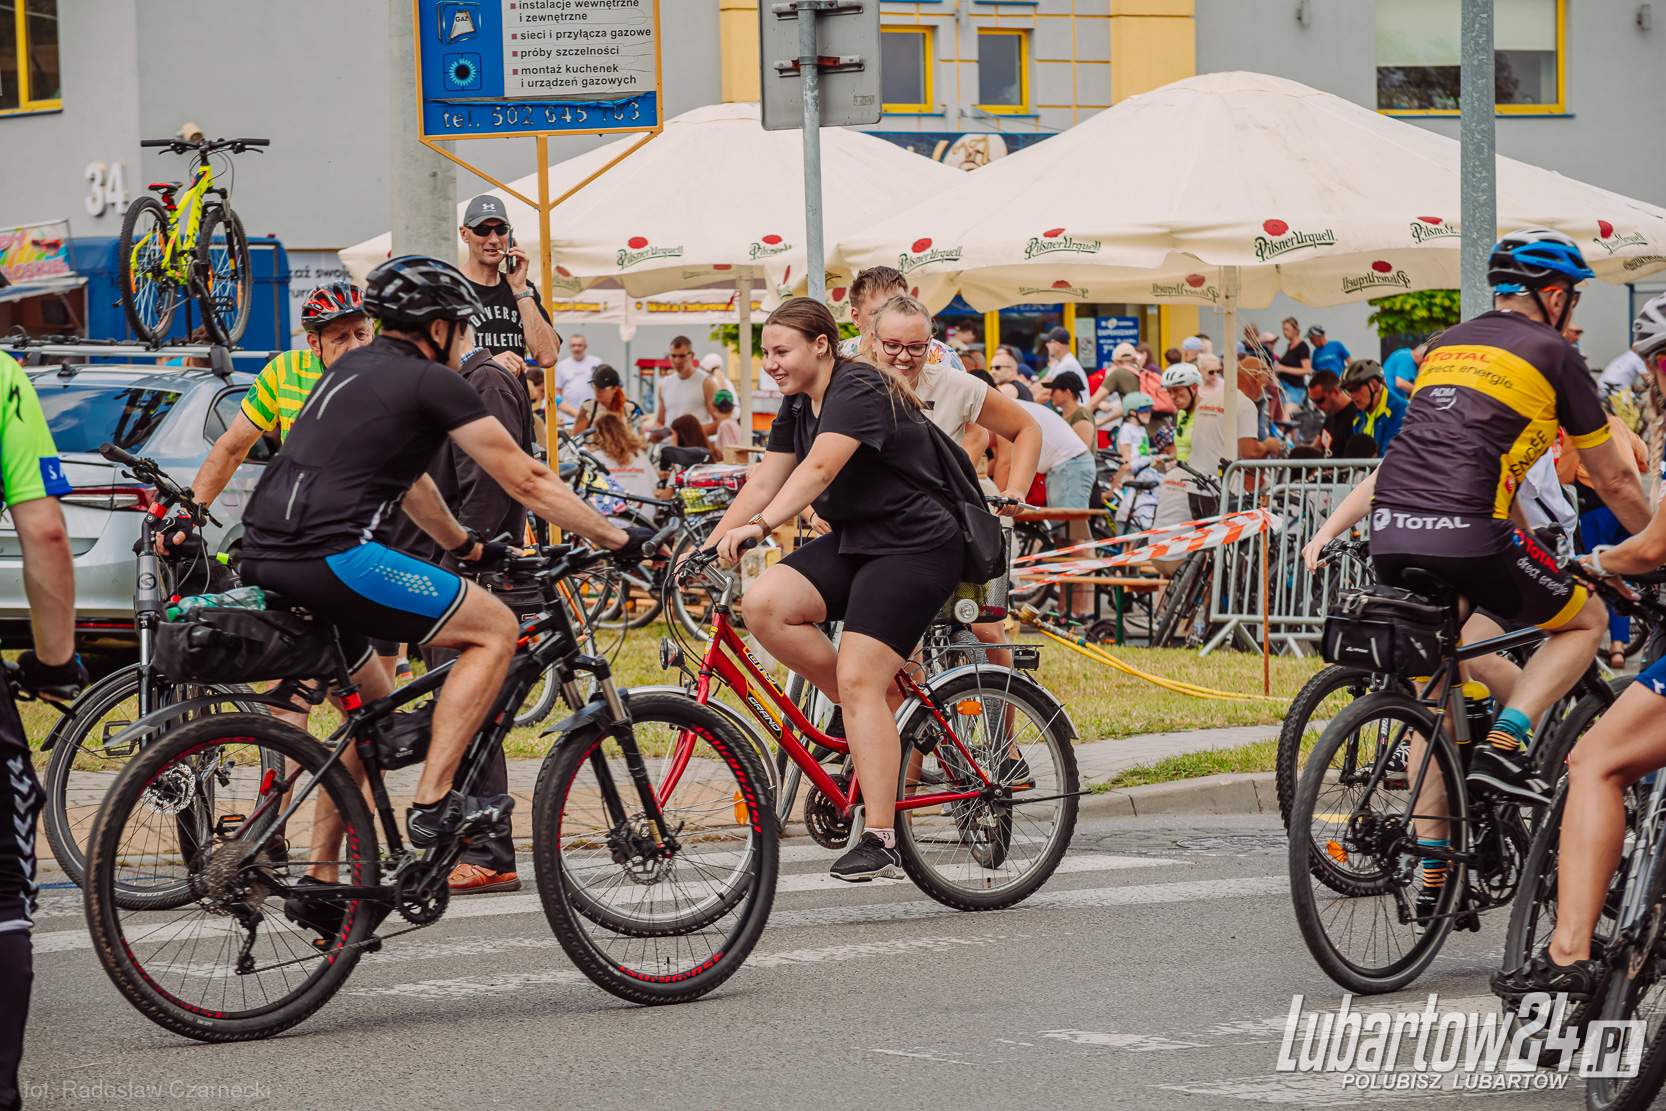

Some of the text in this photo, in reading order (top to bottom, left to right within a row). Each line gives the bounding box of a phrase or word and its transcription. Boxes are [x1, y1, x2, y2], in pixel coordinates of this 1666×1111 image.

[519, 0, 639, 10] instalacje wewnętrzne
[525, 13, 588, 23] zewnętrzne
[520, 30, 546, 40] sieci
[555, 29, 607, 40] przyłącza
[610, 29, 651, 39] gazowe
[520, 45, 619, 59] próby szczelności
[521, 64, 619, 75] montaż kuchenek
[527, 77, 578, 89] urządzeń
[581, 75, 637, 87] gazowych
[443, 110, 480, 128] tel.
[492, 105, 535, 126] 502
[602, 101, 641, 121] 03
[85, 160, 130, 217] 34
[1024, 235, 1102, 260] Pilsner Urquell
[1255, 228, 1336, 263] Pilsner Urquell
[473, 332, 524, 347] THLETIC
[1432, 351, 1490, 363] TOTAL
[1392, 512, 1471, 530] TOTAL
[748, 696, 781, 732] GRAND
